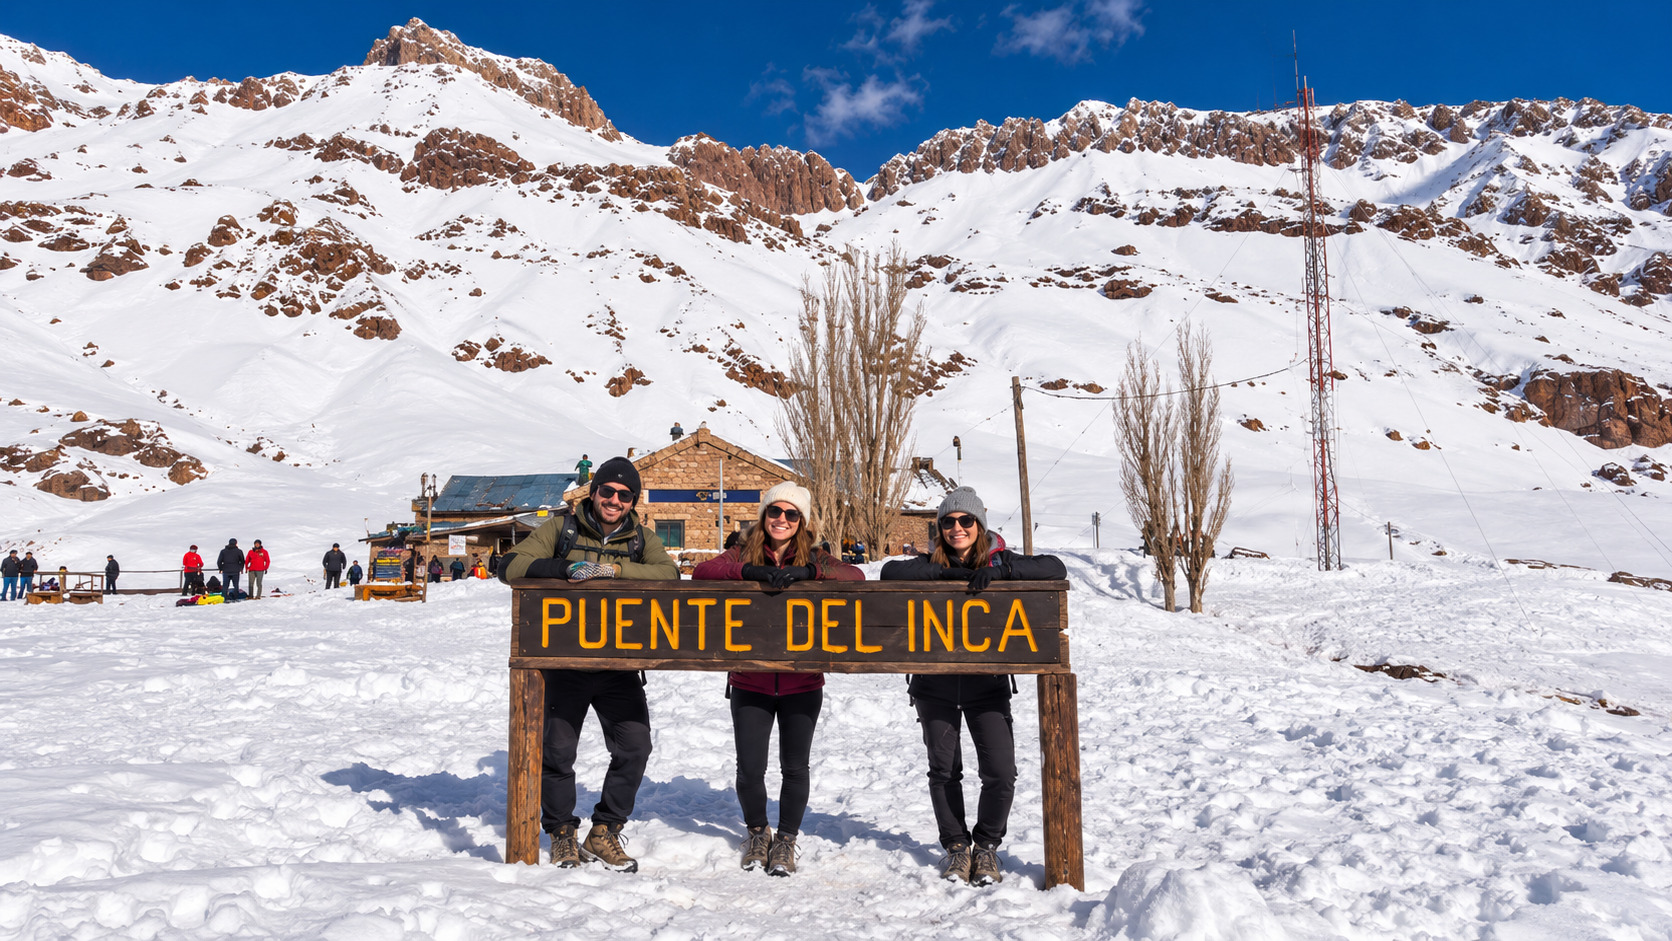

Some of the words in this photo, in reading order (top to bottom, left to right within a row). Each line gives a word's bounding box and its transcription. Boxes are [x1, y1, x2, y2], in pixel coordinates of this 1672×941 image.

[541, 597, 753, 652] PUENTE
[786, 598, 883, 654] DEL
[907, 598, 1039, 653] INCA
